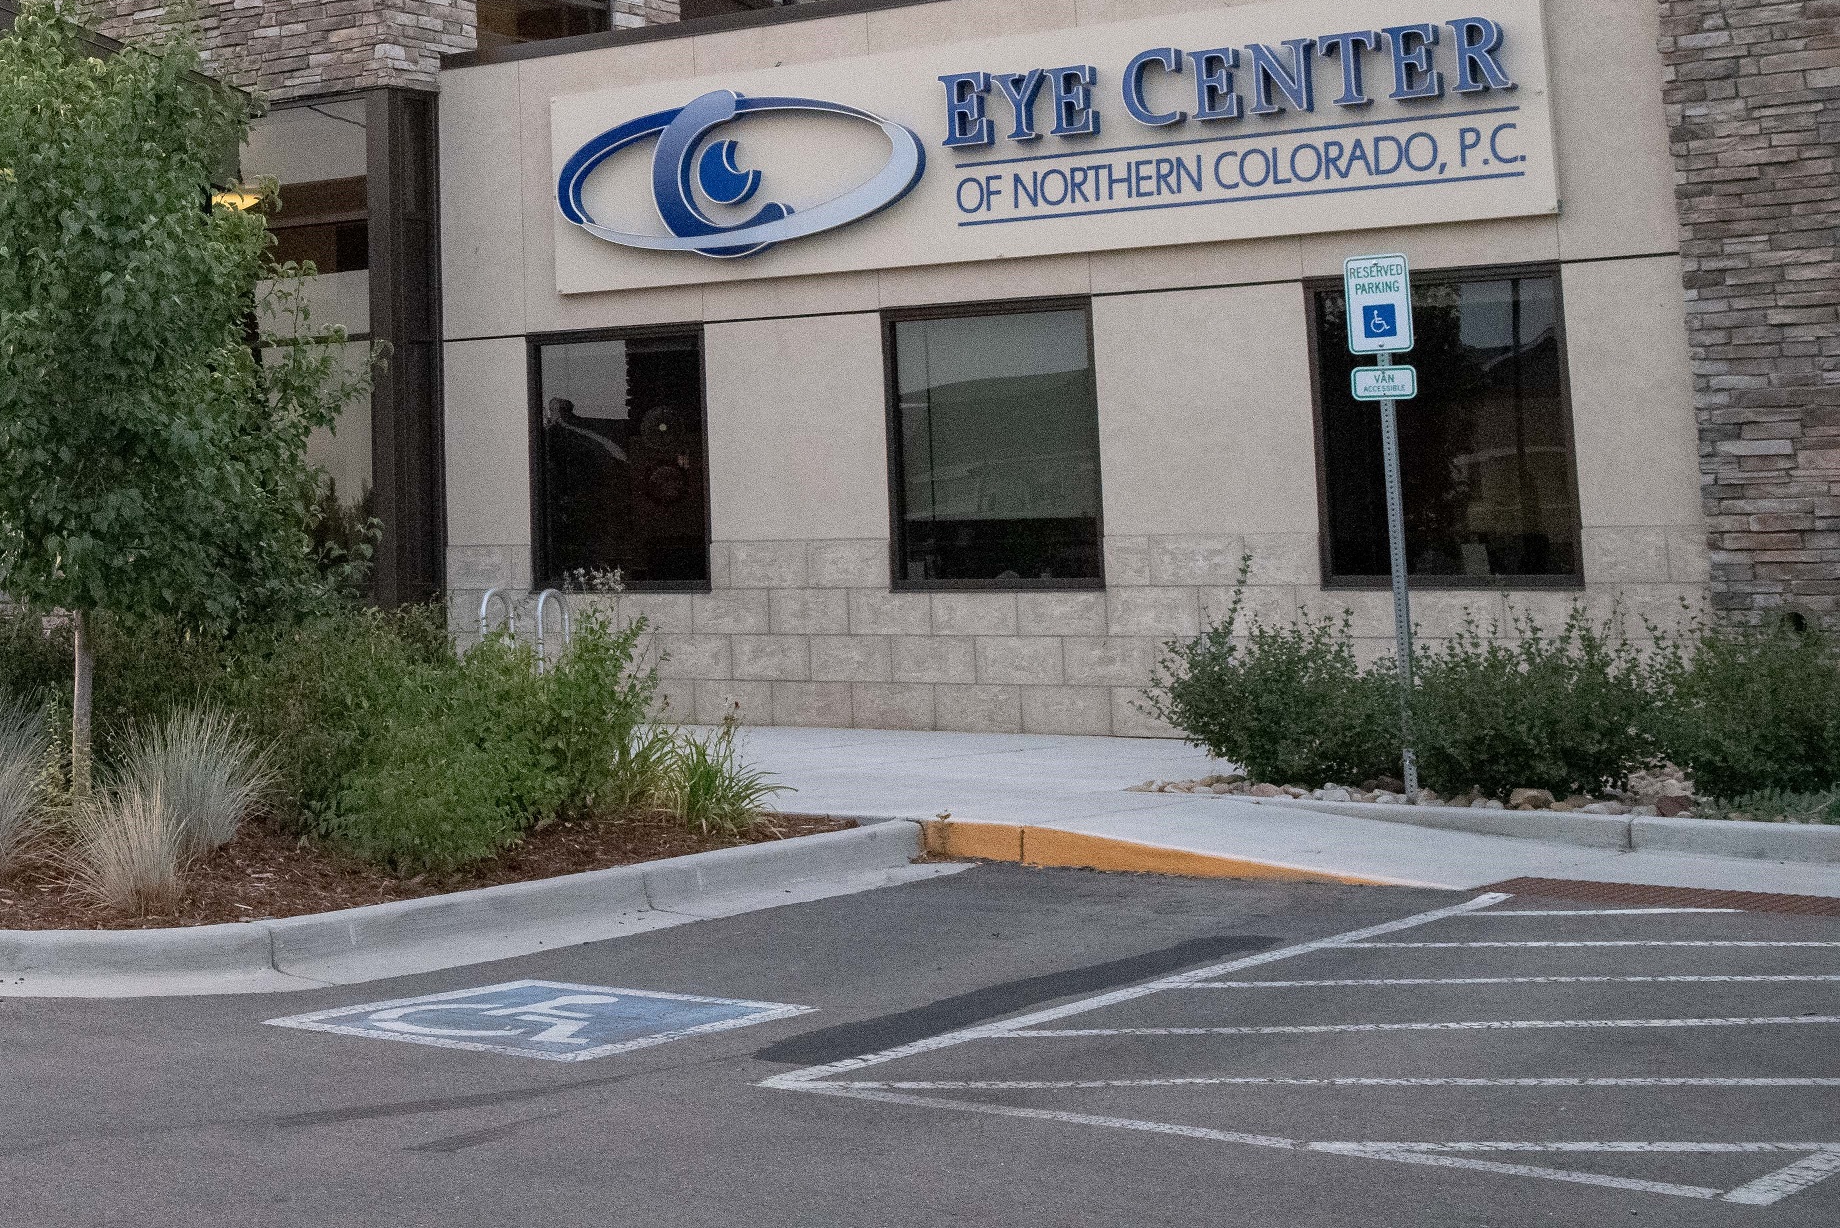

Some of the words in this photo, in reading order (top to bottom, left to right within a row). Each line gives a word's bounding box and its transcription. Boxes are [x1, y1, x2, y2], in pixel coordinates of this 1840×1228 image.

[937, 64, 1101, 148] EYE
[1121, 16, 1519, 127] CENTER
[956, 174, 1003, 214] OF
[1013, 154, 1203, 209] NORTHERN
[1213, 131, 1448, 190] COLORADO,
[1459, 122, 1527, 168] P.C.
[1349, 263, 1403, 280] RESERVED
[1355, 280, 1400, 295] PARKING
[1373, 374, 1395, 383] VAN
[1363, 384, 1406, 393] ACCESSIBLE
